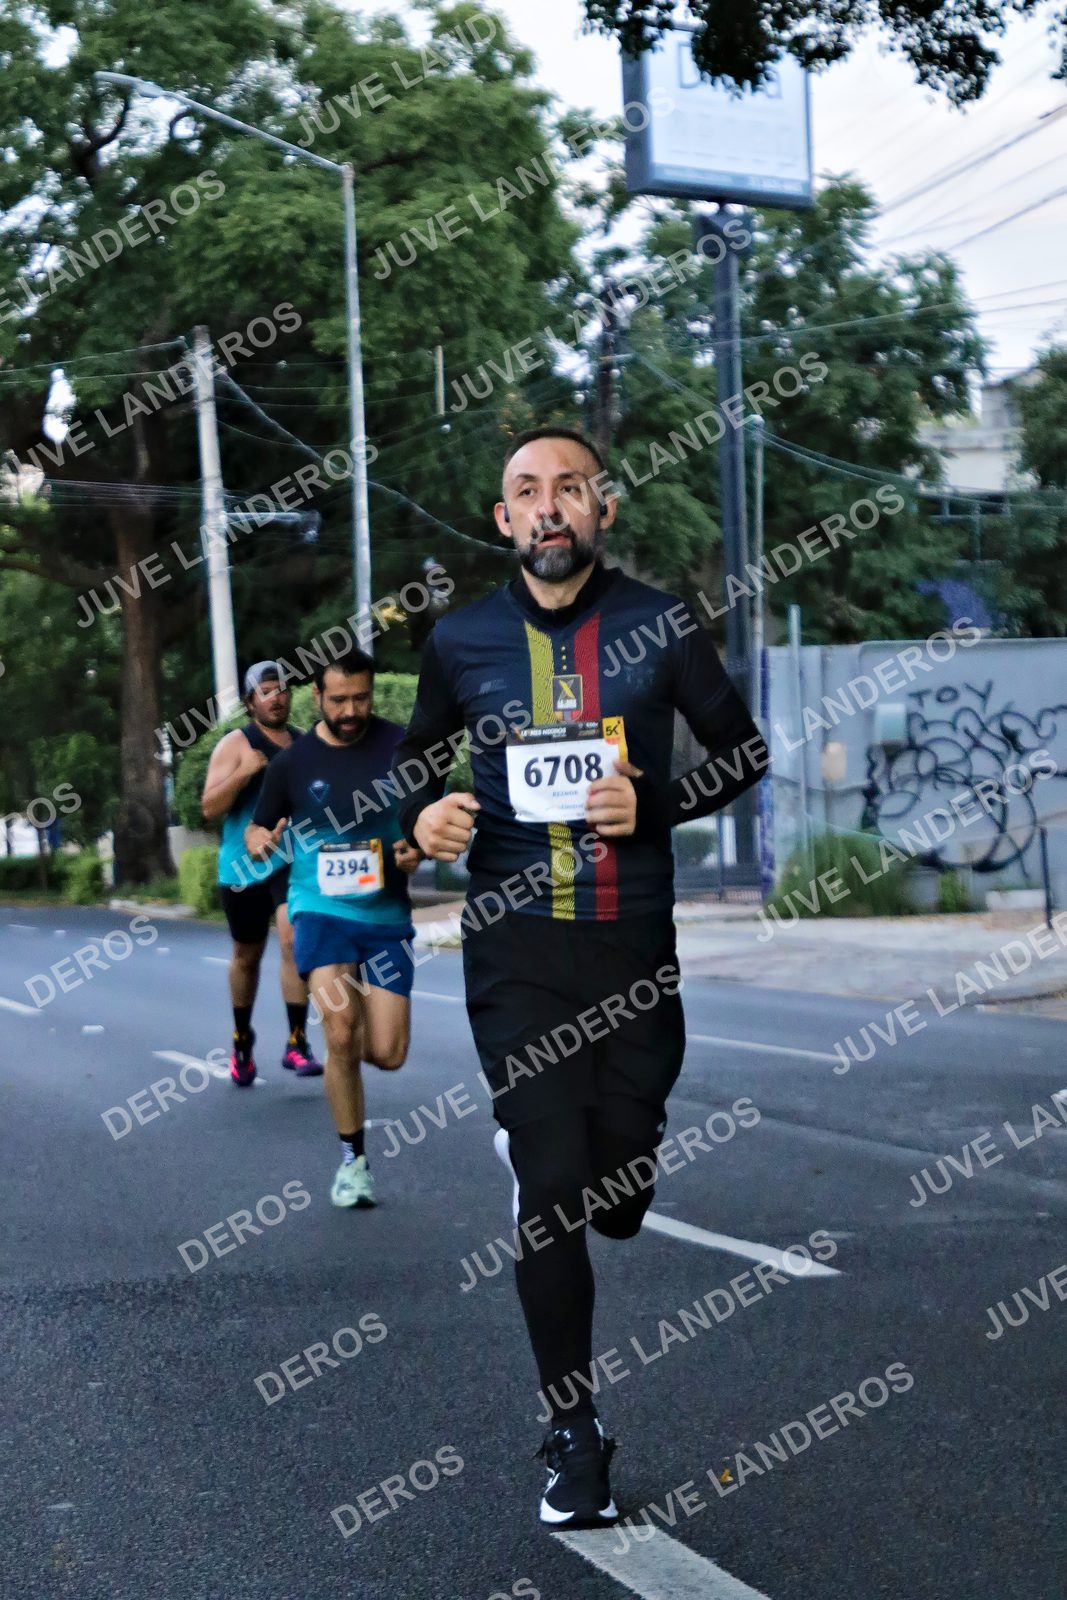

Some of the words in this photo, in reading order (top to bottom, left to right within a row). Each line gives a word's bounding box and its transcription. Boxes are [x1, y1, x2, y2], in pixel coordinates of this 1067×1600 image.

[908, 681, 993, 712] TOY
[524, 752, 604, 787] 6708
[326, 857, 369, 876] 2394
